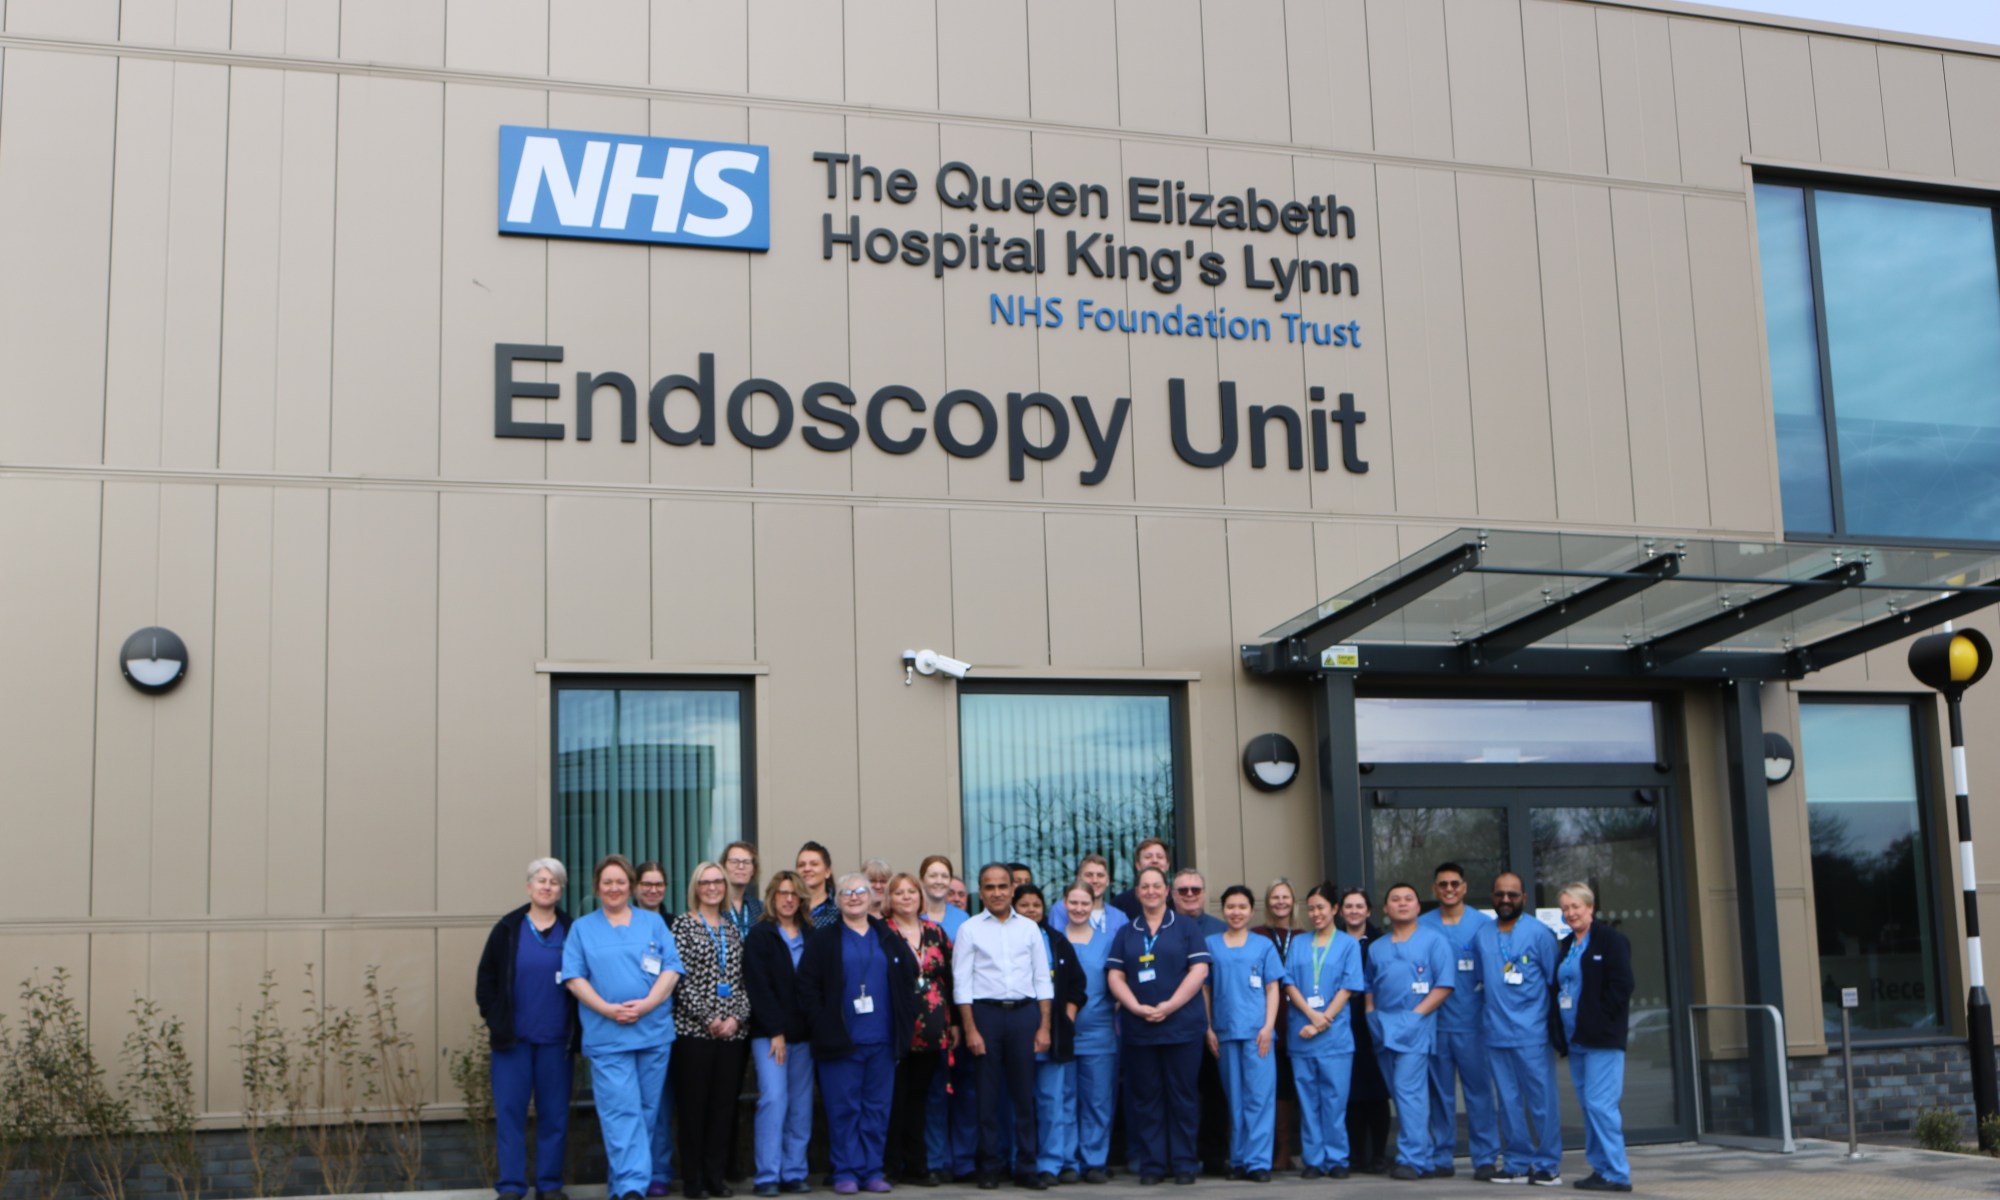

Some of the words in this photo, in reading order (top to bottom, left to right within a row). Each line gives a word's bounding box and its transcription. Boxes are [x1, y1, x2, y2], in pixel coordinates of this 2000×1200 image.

[506, 135, 760, 238] NHS
[813, 151, 918, 206] The
[935, 160, 1109, 220] Queen
[1128, 177, 1356, 240] Elizabeth
[822, 213, 1046, 280] Hospital
[1066, 229, 1228, 296] King's
[1243, 243, 1360, 304] Lynn
[990, 292, 1064, 329] NHS
[1077, 298, 1272, 342] Foundation
[1281, 311, 1361, 348] Trust
[494, 342, 1133, 487] Endoscopy
[1167, 376, 1371, 476] Unit
